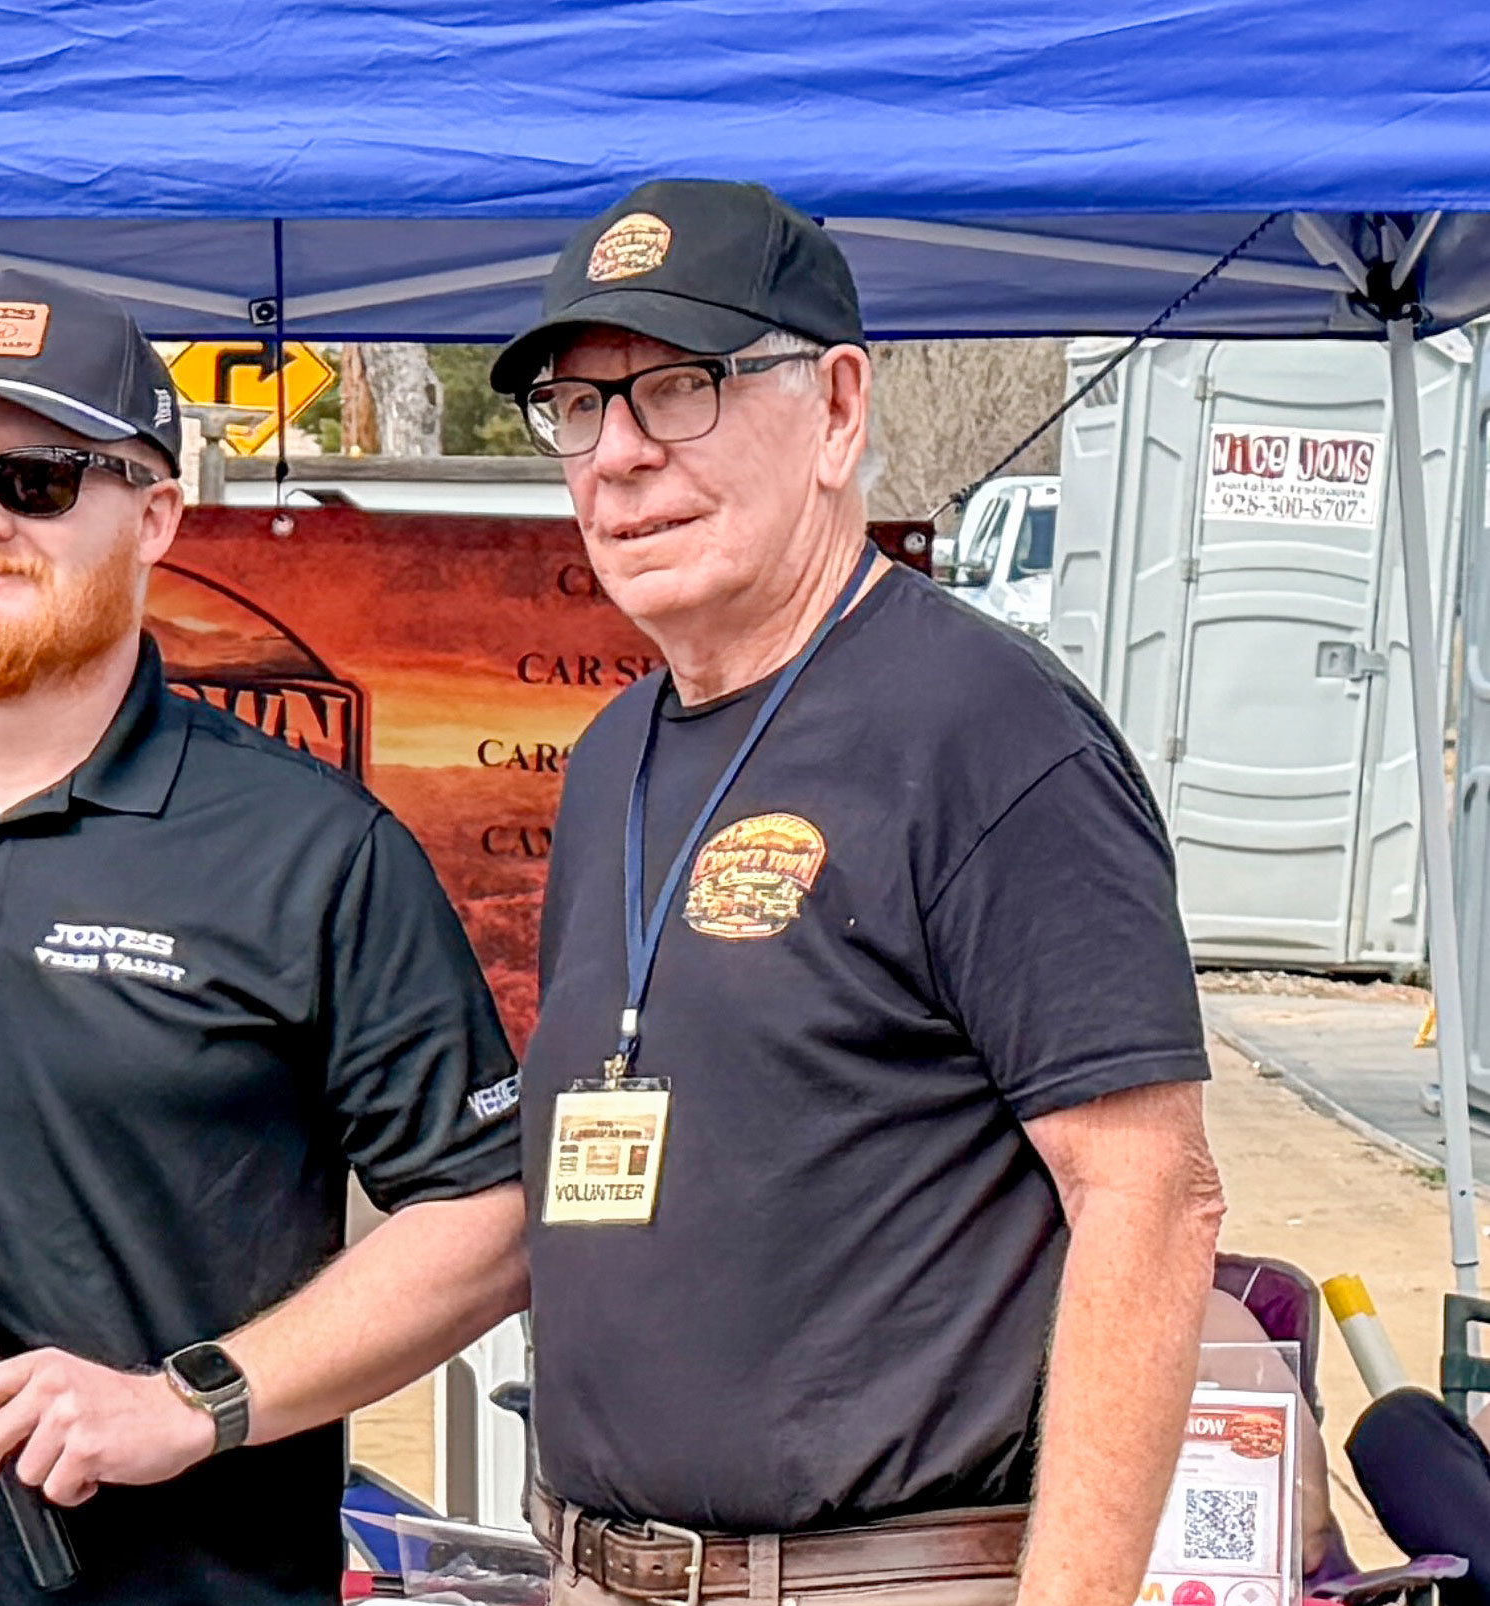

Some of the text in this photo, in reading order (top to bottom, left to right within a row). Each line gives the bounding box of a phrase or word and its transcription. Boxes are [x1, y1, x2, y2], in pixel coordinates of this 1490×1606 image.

[517, 653, 602, 685] CAR
[767, 849, 817, 879] TOWN
[45, 923, 175, 955] JONES
[105, 953, 186, 981] VALLEY
[555, 1183, 645, 1203] VOLUNTEER
